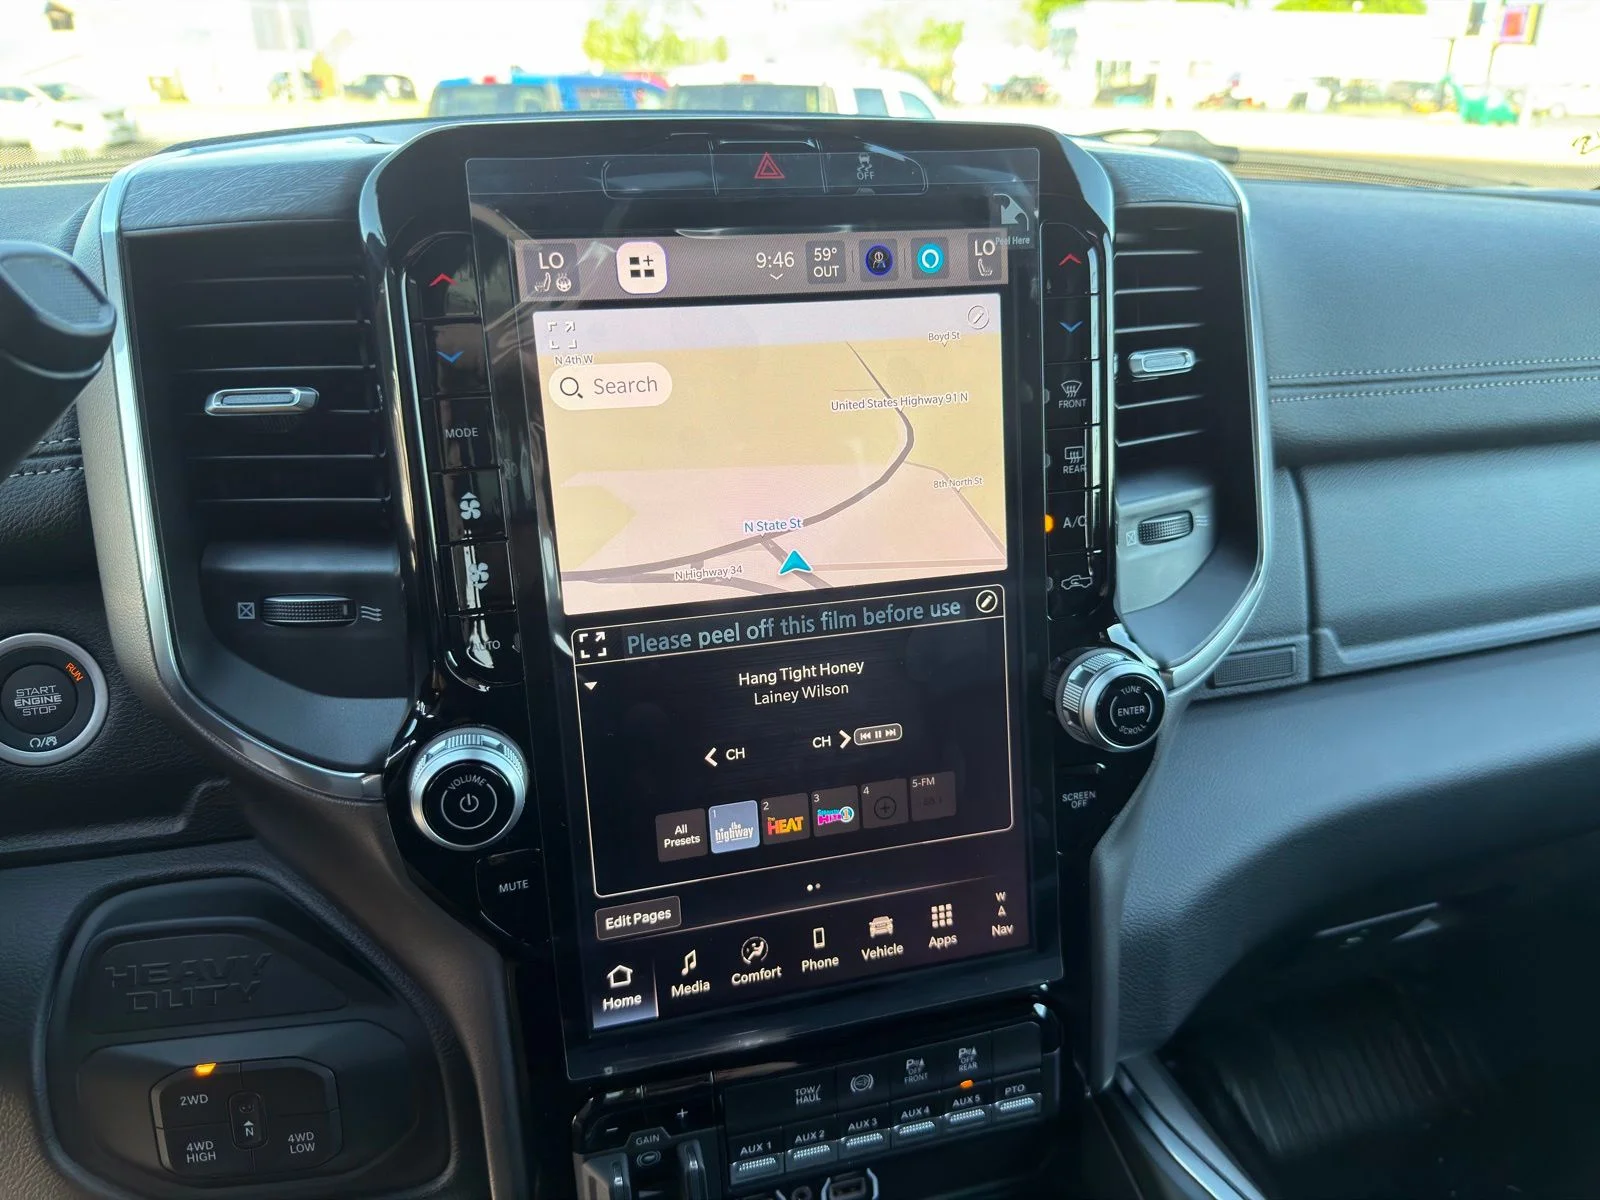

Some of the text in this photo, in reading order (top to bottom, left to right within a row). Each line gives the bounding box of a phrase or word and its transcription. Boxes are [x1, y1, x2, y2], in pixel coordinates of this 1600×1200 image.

[856, 171, 875, 180] OFF
[995, 236, 1031, 246] Peel Here
[974, 239, 996, 257] LO
[538, 251, 565, 270] LO
[755, 251, 796, 269] 9:46
[813, 265, 840, 278] OUT
[928, 331, 961, 343] Boyd St
[555, 354, 594, 365] N 4th W
[593, 375, 658, 395] Search
[831, 392, 969, 411] United States Highway 91 N
[1058, 398, 1087, 409] FRONT
[445, 427, 479, 438] MODE
[1062, 463, 1086, 475] REAR
[933, 476, 983, 489] 8th North St
[744, 517, 802, 533] N State St
[1062, 515, 1087, 529] A/C
[675, 564, 743, 580] N Highway 34
[627, 601, 961, 655] Please peel off this film before use
[65, 662, 84, 682] RUN
[738, 661, 865, 687] Hang Tight Honey
[16, 685, 57, 697] START
[754, 683, 850, 706] Lainey Wilson
[1120, 685, 1141, 695] TUNE
[14, 695, 63, 707] ENGINE
[22, 705, 57, 717] STOP
[1117, 705, 1146, 717] ENTER
[1118, 724, 1147, 735] SCROLL
[812, 735, 832, 749] CH
[725, 748, 746, 761] CH
[448, 774, 487, 791] VOLUME
[912, 777, 935, 788] 5-FM
[862, 786, 870, 795] 4
[1062, 790, 1096, 802] SCREEN
[813, 793, 820, 803] 3
[1071, 799, 1087, 809] OFF
[762, 801, 769, 811] 2
[712, 809, 717, 818] 1
[674, 823, 688, 835] All
[730, 821, 742, 830] the
[767, 816, 804, 836] HEAT
[715, 826, 754, 842] highway
[663, 834, 701, 849] Presets
[499, 879, 529, 894] MUTE
[605, 908, 672, 931] Edit Pages
[991, 924, 1014, 937] Nav
[928, 934, 958, 950] Apps
[861, 943, 904, 962] Vehicle
[105, 953, 272, 988] HEAVY
[801, 955, 840, 973] Phone
[731, 965, 782, 986] Comfort
[126, 980, 260, 1011] DUTY
[670, 979, 711, 999] Media
[602, 993, 642, 1013] Home
[958, 1061, 978, 1073] REAR
[904, 1072, 928, 1085] FRONT
[1004, 1083, 1026, 1096] PTO
[180, 1093, 209, 1107] 2WD
[796, 1094, 822, 1106] HAUL
[952, 1094, 981, 1108] AUX 5
[901, 1106, 930, 1119] AUX 4
[847, 1117, 878, 1132] AUX 3
[245, 1127, 254, 1137] N
[287, 1131, 315, 1145] 4WD
[795, 1129, 825, 1144] AUX 2
[636, 1133, 660, 1146] GAIN
[186, 1140, 215, 1153] 4WD
[289, 1142, 316, 1155] LOW
[740, 1141, 772, 1155] AUX 1
[186, 1151, 217, 1164] HIGH
